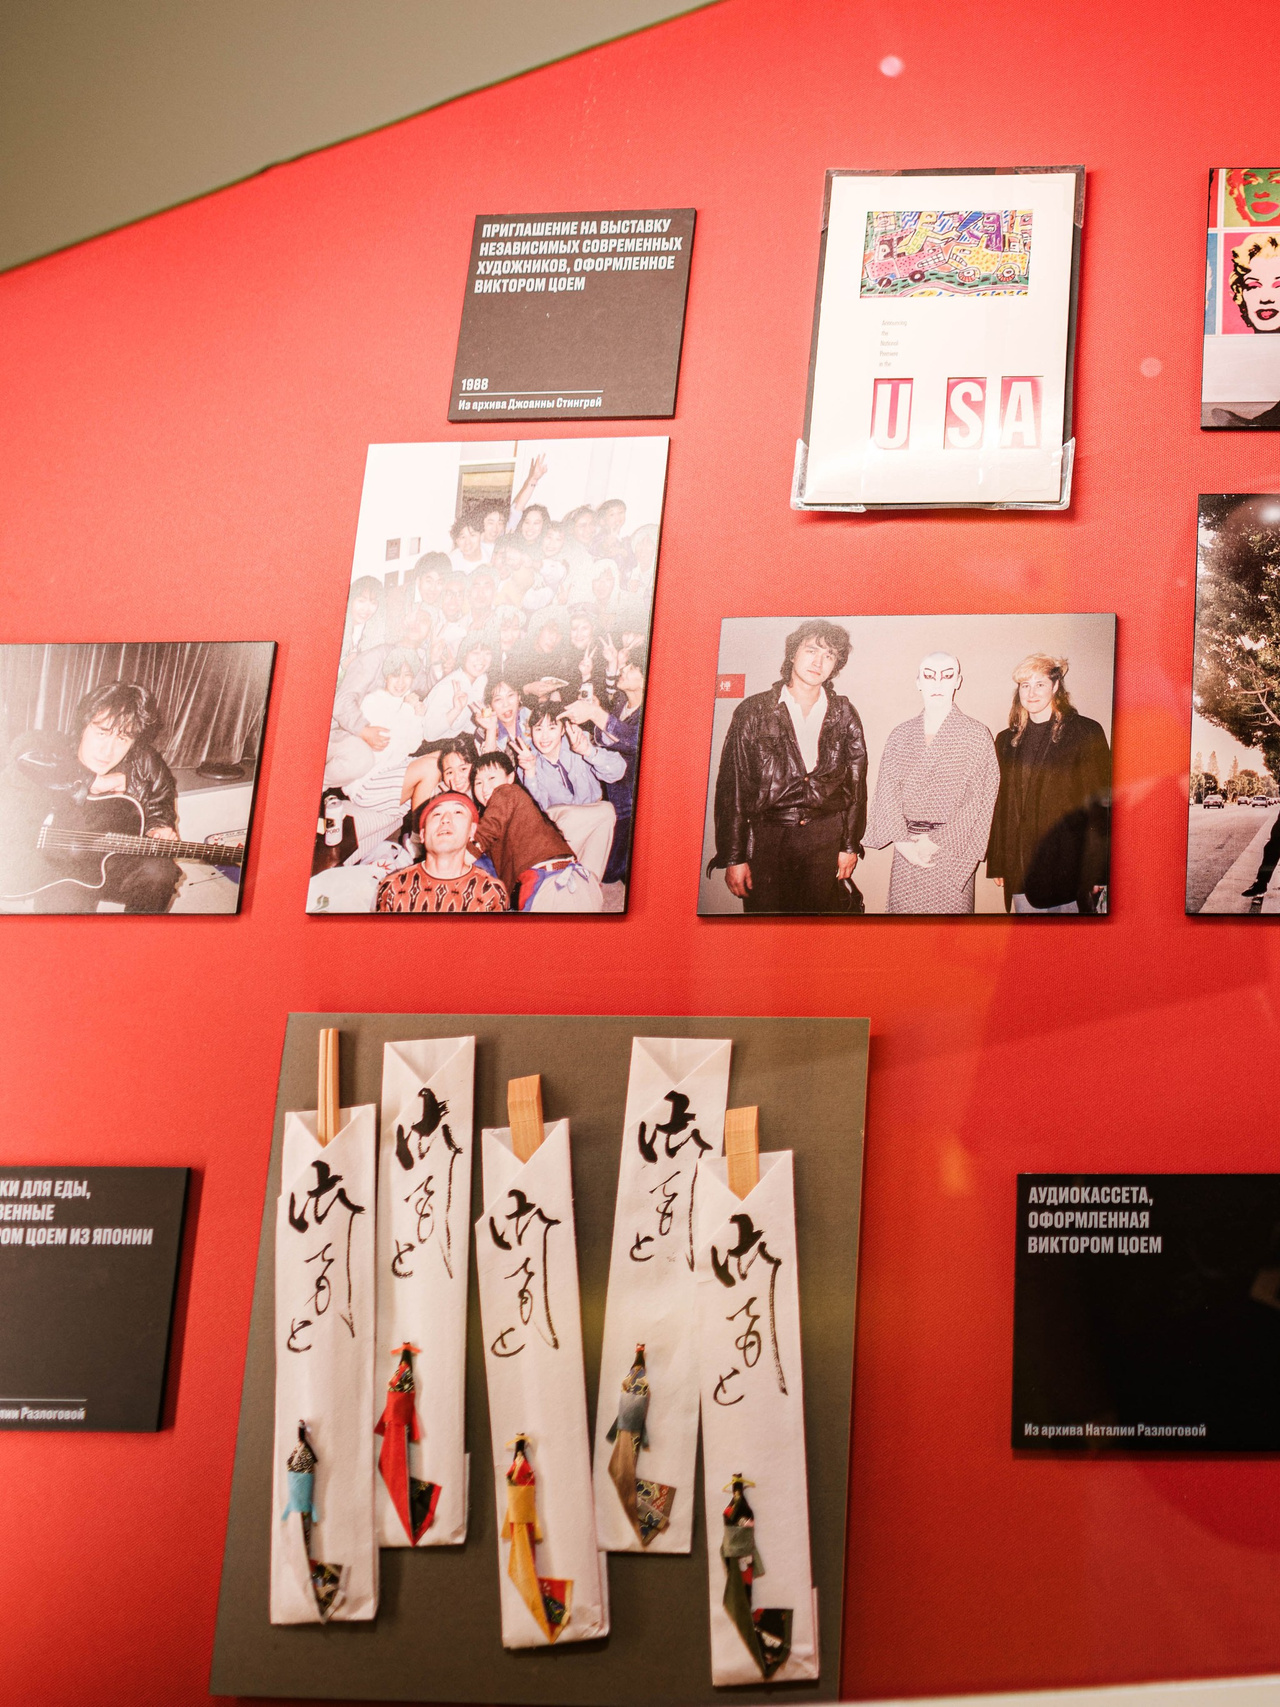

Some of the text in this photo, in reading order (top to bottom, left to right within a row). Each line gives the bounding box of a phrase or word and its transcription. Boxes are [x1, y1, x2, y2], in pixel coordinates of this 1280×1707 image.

[482, 219, 671, 238] ПРИГЛАШЕНИЕ НА ВЫСТАВКУ
[479, 237, 683, 256] НЕЗАВИСИМЫХ СОВРЕМЕННЫХ
[476, 256, 675, 275] ХУДОЖНИКОВ, ОФОРМЛЕННОЕ
[474, 277, 585, 293] ВИКТОРОМ ЦОЕМ
[461, 378, 489, 391] 1988
[458, 397, 602, 412] Из архива Джоанны Стингрей
[20, 1180, 52, 1198] ДЛЯ
[54, 1181, 91, 1199] ЕДЫ,
[1028, 1186, 1153, 1206] АУДИОКАССЕТА,
[1028, 1211, 1150, 1229] ОФОРМЛЕННАЯ
[25, 1228, 66, 1246] ЦОЕМ
[69, 1228, 90, 1245] ИЗ
[92, 1228, 154, 1245] ЯПОНИИ
[1027, 1236, 1162, 1255] ВИКТОРОМ ЦОЕМ
[20, 1407, 87, 1420] Разлоговой
[1024, 1423, 1206, 1438] Из архива Наталии Разлоговой
